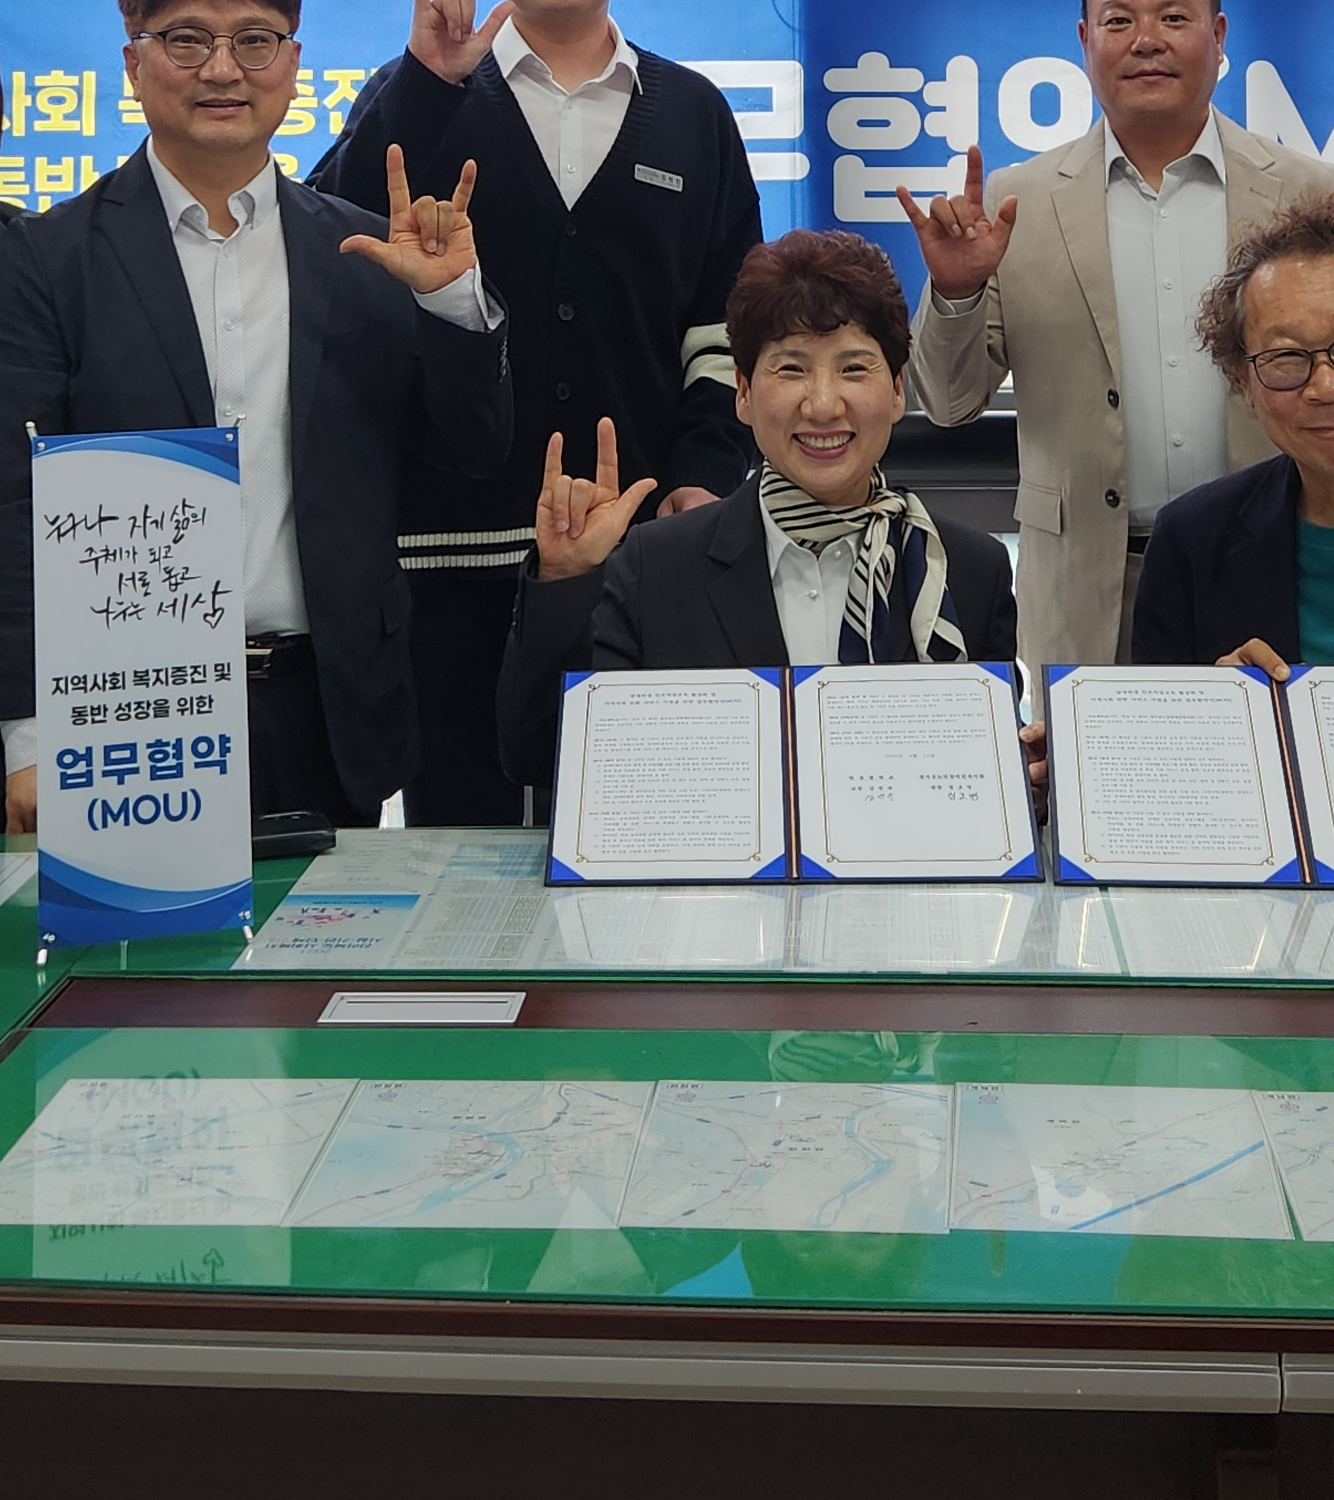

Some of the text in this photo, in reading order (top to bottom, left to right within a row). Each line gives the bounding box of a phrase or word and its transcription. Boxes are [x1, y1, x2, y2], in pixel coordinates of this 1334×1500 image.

[128, 503, 165, 540] 자기
[170, 497, 206, 544] 삶의
[79, 544, 174, 576] 주체가 되고
[118, 566, 202, 597] 서로 돕고
[156, 580, 233, 629] 세상
[51, 662, 232, 696] 지역사회 복지증진 및
[70, 694, 214, 726] 동반 성장을 위한
[55, 733, 232, 790] 업무협약
[87, 788, 202, 832] (MOU)
